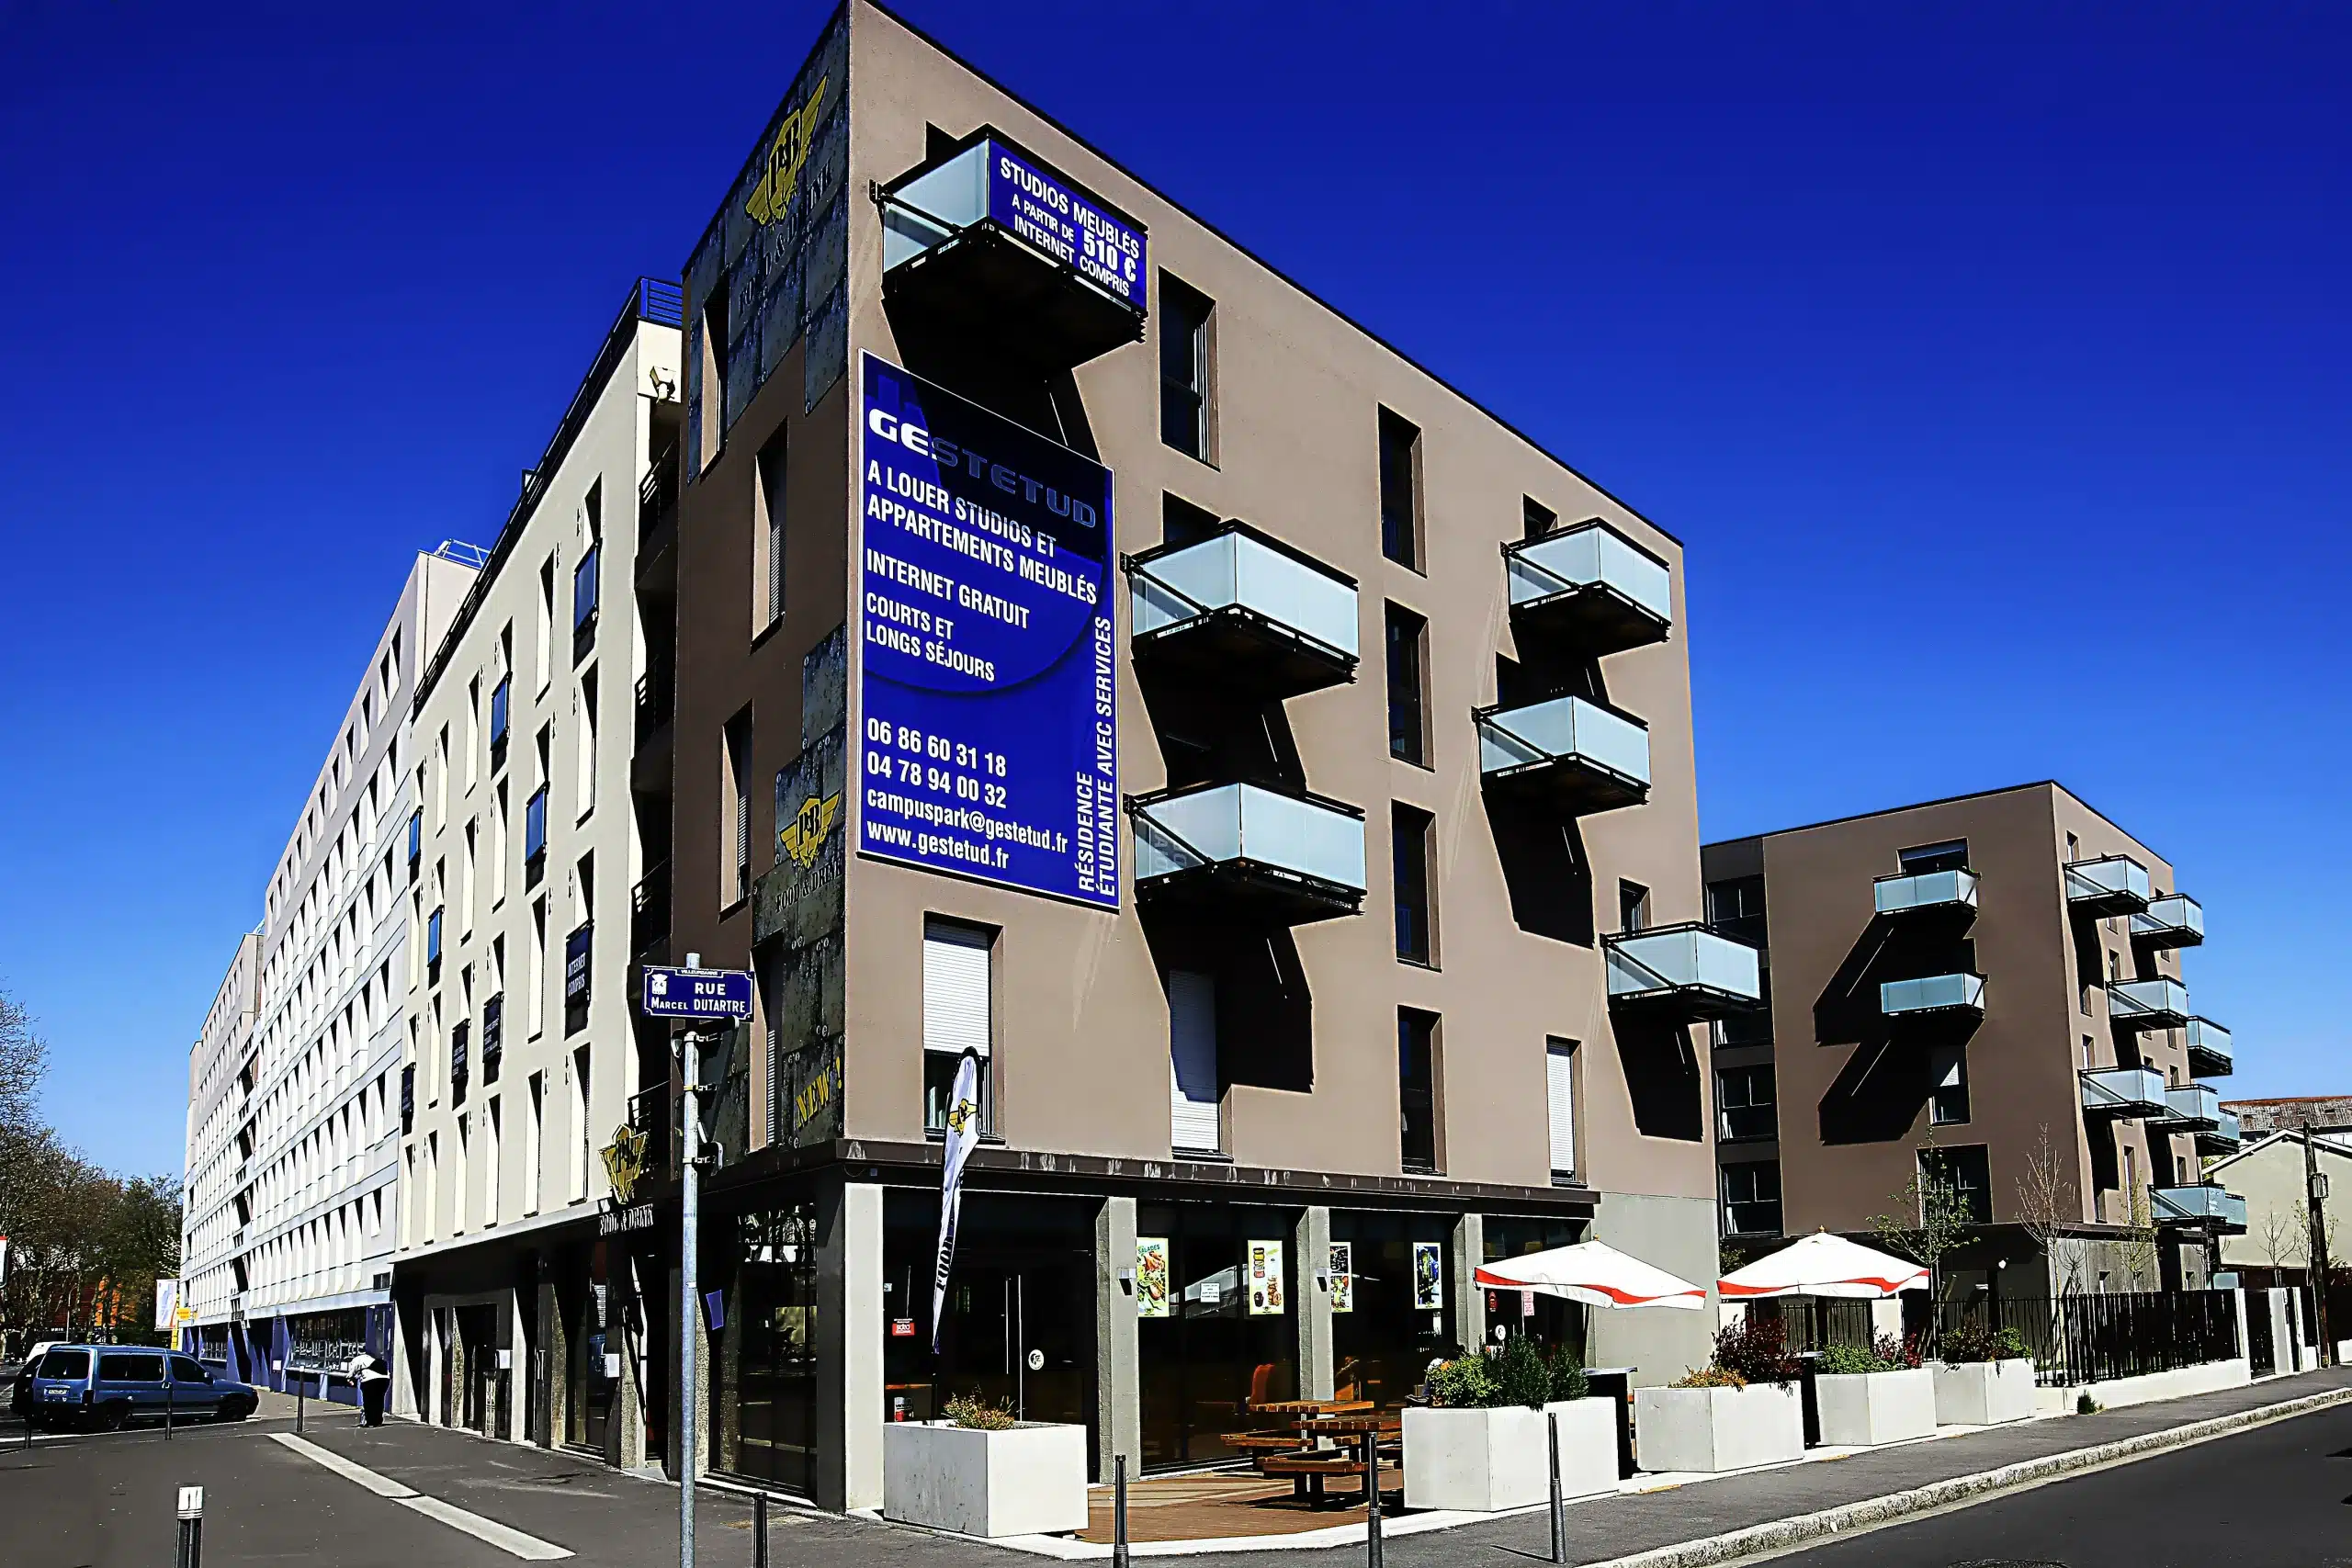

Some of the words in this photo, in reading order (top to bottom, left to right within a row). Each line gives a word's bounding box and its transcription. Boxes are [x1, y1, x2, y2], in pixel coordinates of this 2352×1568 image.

[1001, 157, 1069, 214] STUDIOS
[1073, 201, 1139, 259] MEUBLÉS
[1012, 194, 1021, 209] A
[1023, 199, 1058, 232] PARTIR
[1061, 223, 1074, 243] DE
[1083, 229, 1118, 271] 510
[1124, 257, 1136, 282] €
[1014, 214, 1075, 264] INTERNET
[1080, 255, 1130, 297] COMPRIS
[868, 408, 1096, 528] GESTETUD
[867, 459, 881, 486] A
[887, 467, 949, 514] LOUER
[955, 497, 1032, 548] STUDIOS
[1037, 531, 1057, 558] ET
[867, 493, 1013, 572] APPARTEMENTS
[1019, 555, 1097, 605] MEUBLÉS
[865, 592, 931, 633] COURTS
[934, 616, 955, 640] ET
[866, 547, 955, 601] INTERNET
[958, 584, 1030, 629] GRATUIT
[865, 620, 921, 657] LONGS
[925, 640, 995, 682] SÉJOURS
[1094, 616, 1112, 716] SERVICES
[867, 717, 891, 745] 06
[898, 726, 922, 753] 86
[927, 735, 950, 761] 60
[956, 743, 978, 769] 31
[984, 752, 1006, 777] 18
[867, 750, 891, 779] 04
[898, 759, 922, 786] 78
[927, 767, 950, 795] 94
[956, 775, 979, 802] 00
[984, 782, 1007, 809] 32
[1095, 722, 1114, 776] AVEC
[866, 819, 1010, 869] www.gestetud.fr
[867, 788, 1069, 854] campuspark@gestetud.fr
[1073, 772, 1095, 892] RÉSIDENCE
[1095, 779, 1115, 897] ÉTUDIANTE
[775, 882, 801, 914] FOOD
[810, 860, 842, 893] DRINK
[693, 998, 746, 1013] DUTARTRE
[695, 982, 726, 996] RUE
[796, 1066, 830, 1129] NEW
